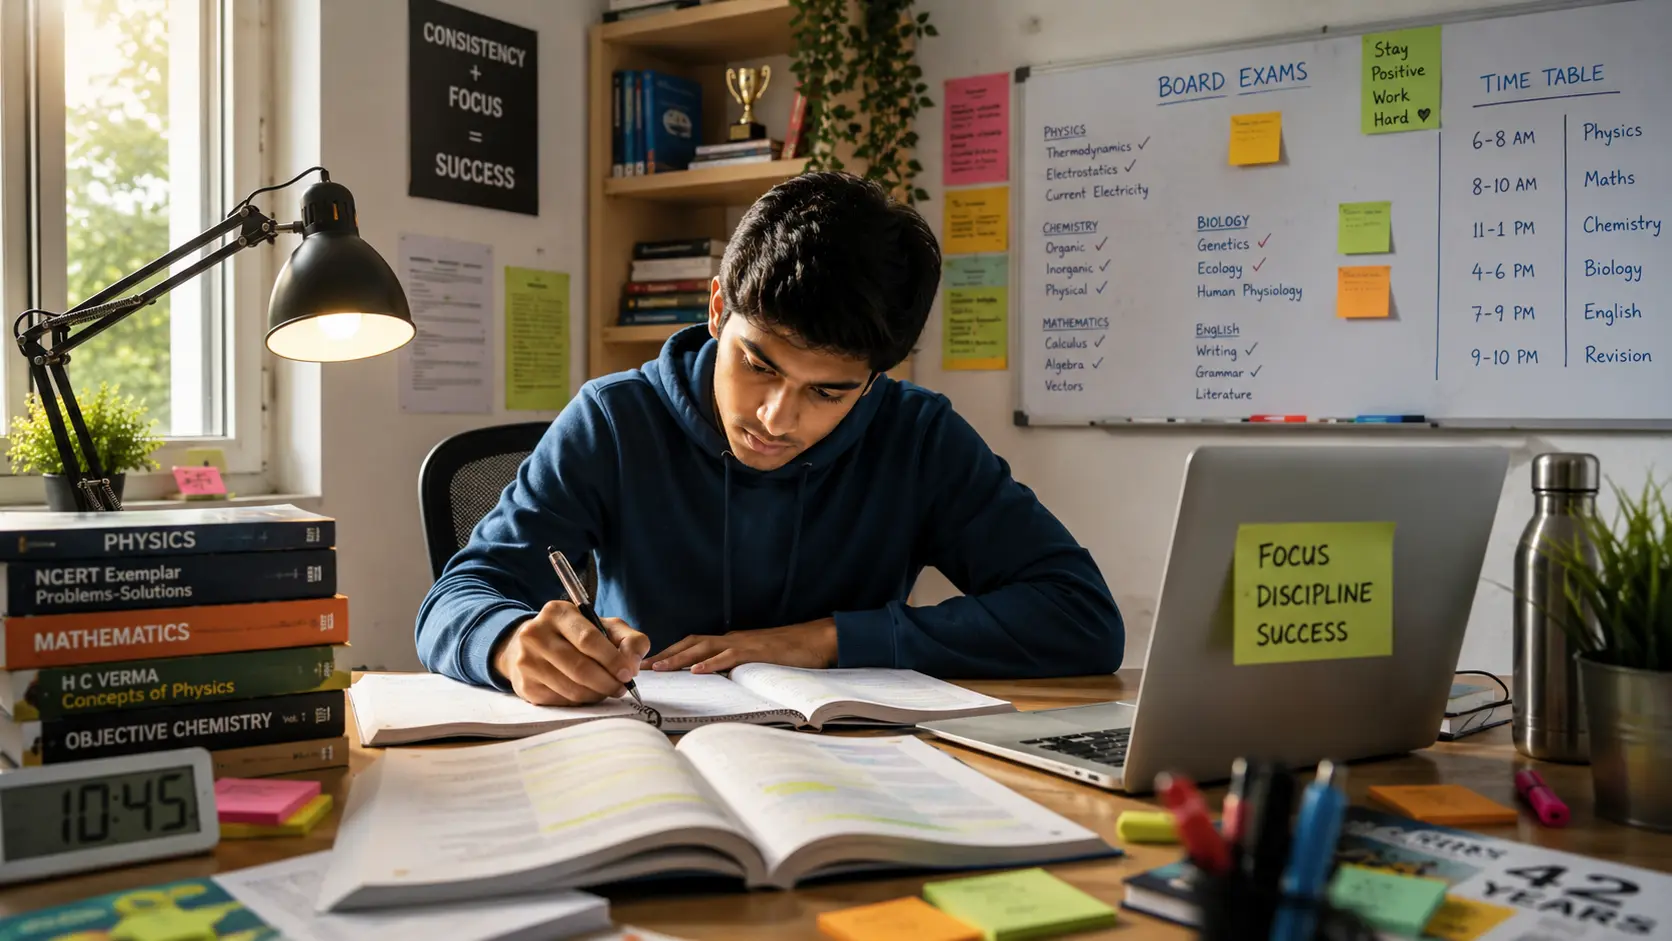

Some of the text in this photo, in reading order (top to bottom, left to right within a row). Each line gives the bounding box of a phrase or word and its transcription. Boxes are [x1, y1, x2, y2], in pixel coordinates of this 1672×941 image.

[423, 22, 526, 67] CONSISTENCY
[1375, 41, 1408, 61] Stay
[1158, 61, 1308, 98] BOARD EXAMS
[1372, 65, 1426, 81] Positive
[1480, 64, 1605, 93] TIME TABLE
[449, 86, 503, 118] FOCUS
[1373, 87, 1410, 104] Work
[1374, 109, 1409, 127] Hard
[1043, 124, 1087, 139] PHYSICS
[1472, 130, 1536, 150] 6-8 AM
[1583, 122, 1643, 146] Physics
[1046, 142, 1132, 160] Thermodynamics
[435, 152, 515, 189] SUCCESS
[1046, 165, 1119, 181] Electrostatics
[1584, 169, 1635, 187] Maths
[1045, 183, 1149, 202] Current Electricity
[1472, 177, 1538, 195] 8-10 AM
[1043, 221, 1099, 234] CHEMISTRY
[1197, 215, 1250, 229] BIOLOGY
[1473, 220, 1536, 238] 11-1 PM
[1583, 215, 1662, 237] Chemistry
[1045, 241, 1086, 258] Organic
[1197, 238, 1250, 251] Genetics
[1046, 262, 1094, 279] Inorganic
[1197, 261, 1243, 279] Ecology
[1472, 262, 1535, 281] 4-6 PM
[1584, 259, 1642, 282] Biology
[1045, 283, 1088, 301] Physical
[1197, 283, 1303, 302] Human Physiology
[1471, 304, 1535, 322] 7-9 PM
[1584, 302, 1642, 326] English
[1042, 317, 1110, 329] MATHEMATICS
[1045, 337, 1088, 350] Calculus
[1196, 345, 1237, 361] Writing
[1471, 348, 1538, 366] 9-10 PM
[1585, 345, 1652, 363] Revision
[1045, 358, 1085, 375] Algebra
[1195, 365, 1244, 378] Grammar
[1045, 380, 1084, 392] Vectors
[1196, 388, 1253, 400] Literature
[104, 531, 196, 551] PHYSICS
[1258, 542, 1330, 569] FOCUS
[35, 565, 182, 586] NCERT Exemplar
[36, 584, 193, 605] Problems-Solutions
[1257, 582, 1373, 608] DISCIPLINE
[34, 622, 190, 652] MATHEMATICS
[1257, 621, 1348, 646] SUCCESS
[61, 668, 159, 691] H C VERMA
[61, 680, 235, 709] Concepts of Physics
[65, 722, 168, 750] OBJECTIVE
[173, 712, 273, 738] CHEMISTRY
[61, 774, 187, 844] 10:45
[1505, 865, 1641, 909] 42
[1483, 880, 1657, 934] YEARS
